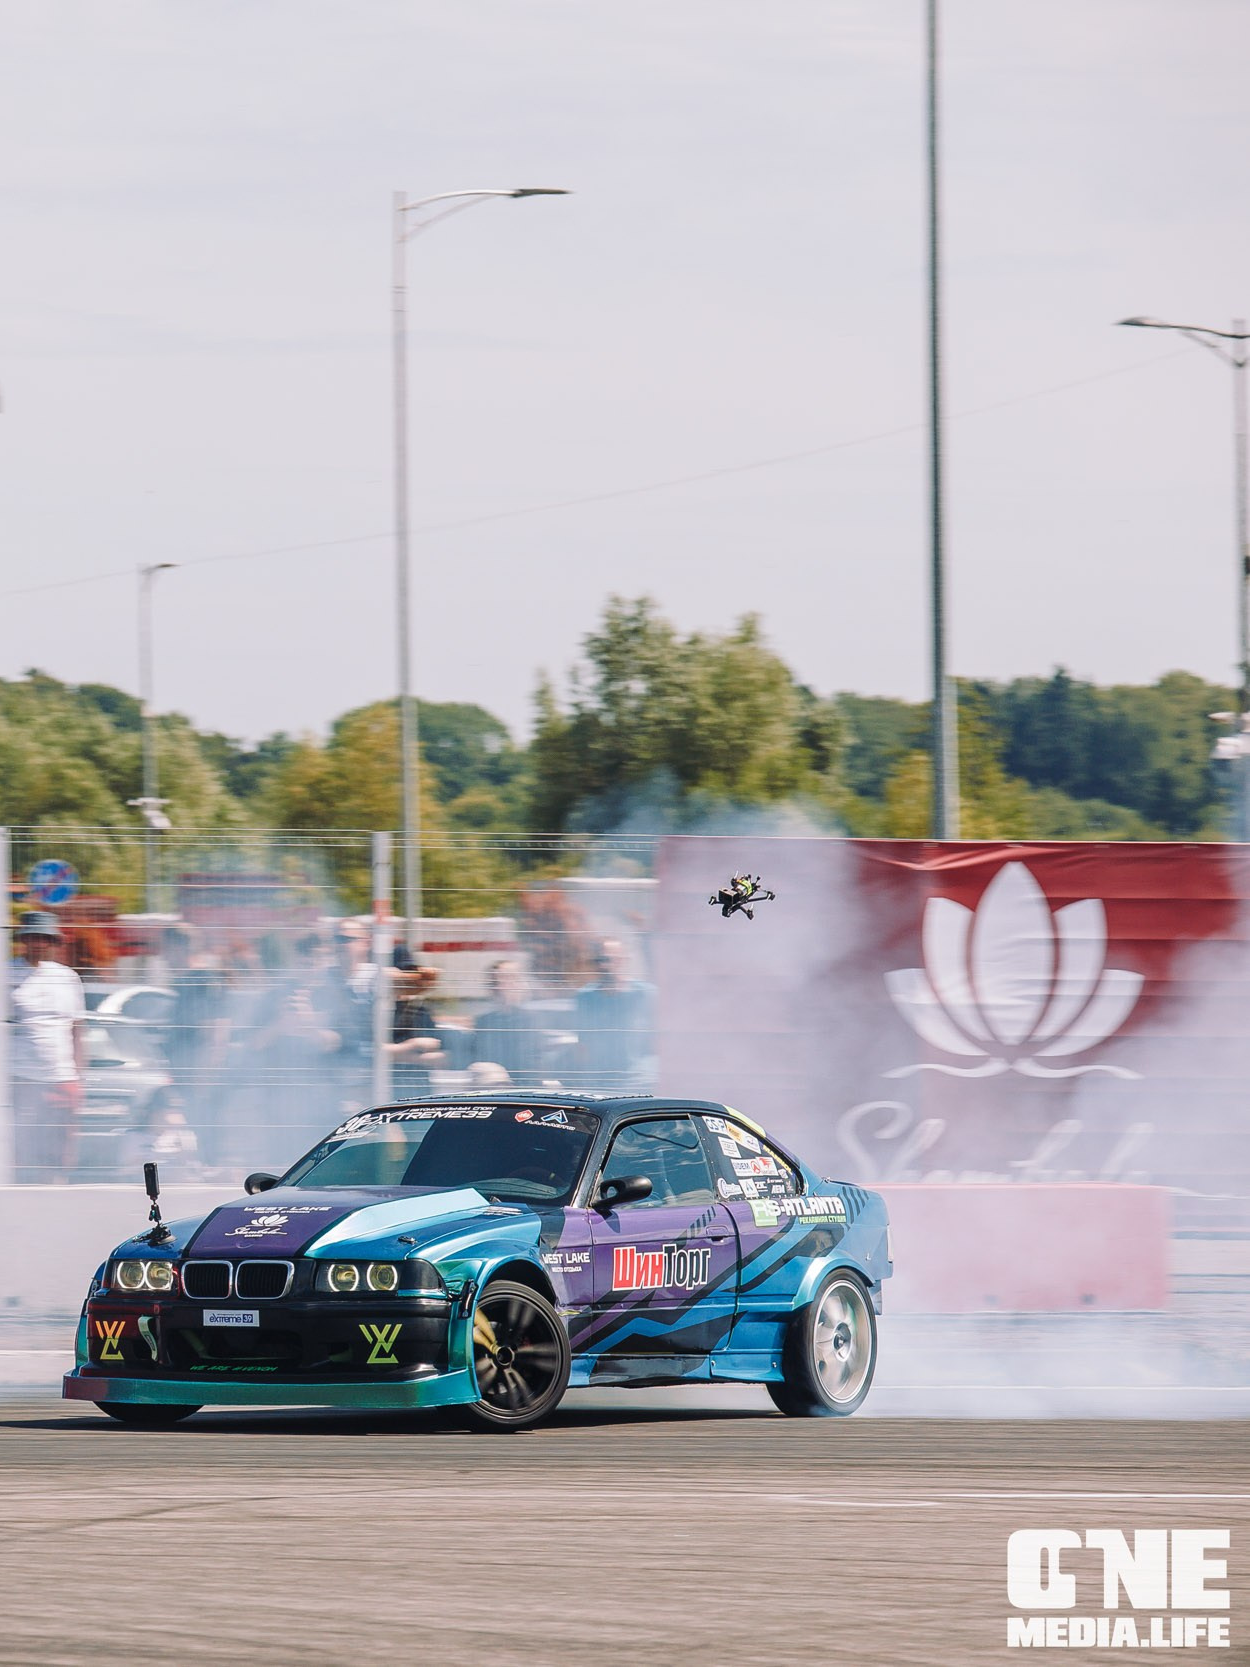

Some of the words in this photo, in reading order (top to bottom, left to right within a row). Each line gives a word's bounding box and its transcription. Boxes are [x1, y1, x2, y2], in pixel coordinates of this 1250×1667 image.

[542, 1253, 563, 1264] WEST
[565, 1252, 591, 1264] LAKE
[612, 1243, 711, 1292] ШинТорг
